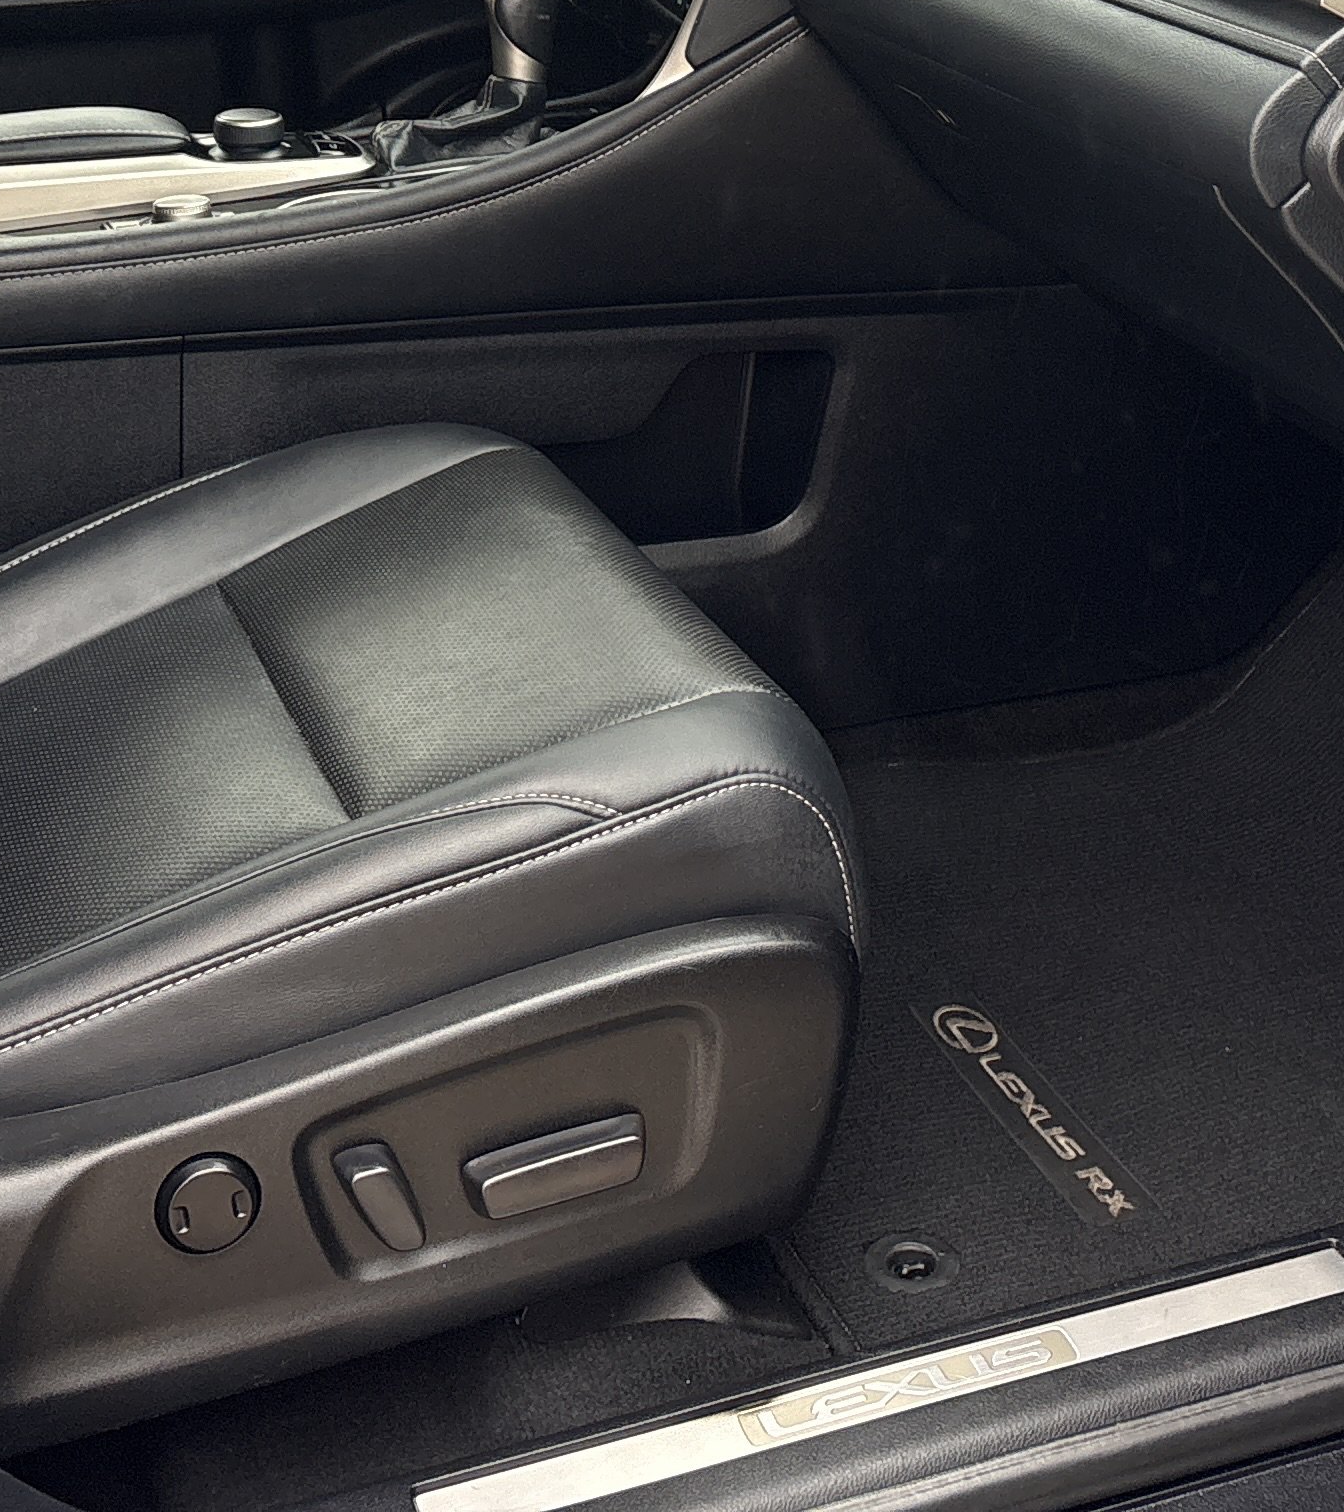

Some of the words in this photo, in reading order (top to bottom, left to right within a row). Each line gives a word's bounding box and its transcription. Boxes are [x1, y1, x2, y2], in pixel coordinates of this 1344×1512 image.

[979, 1053, 1087, 1161] LEXUS
[1074, 1166, 1137, 1218] RX
[757, 1339, 1054, 1438] LEXUS
